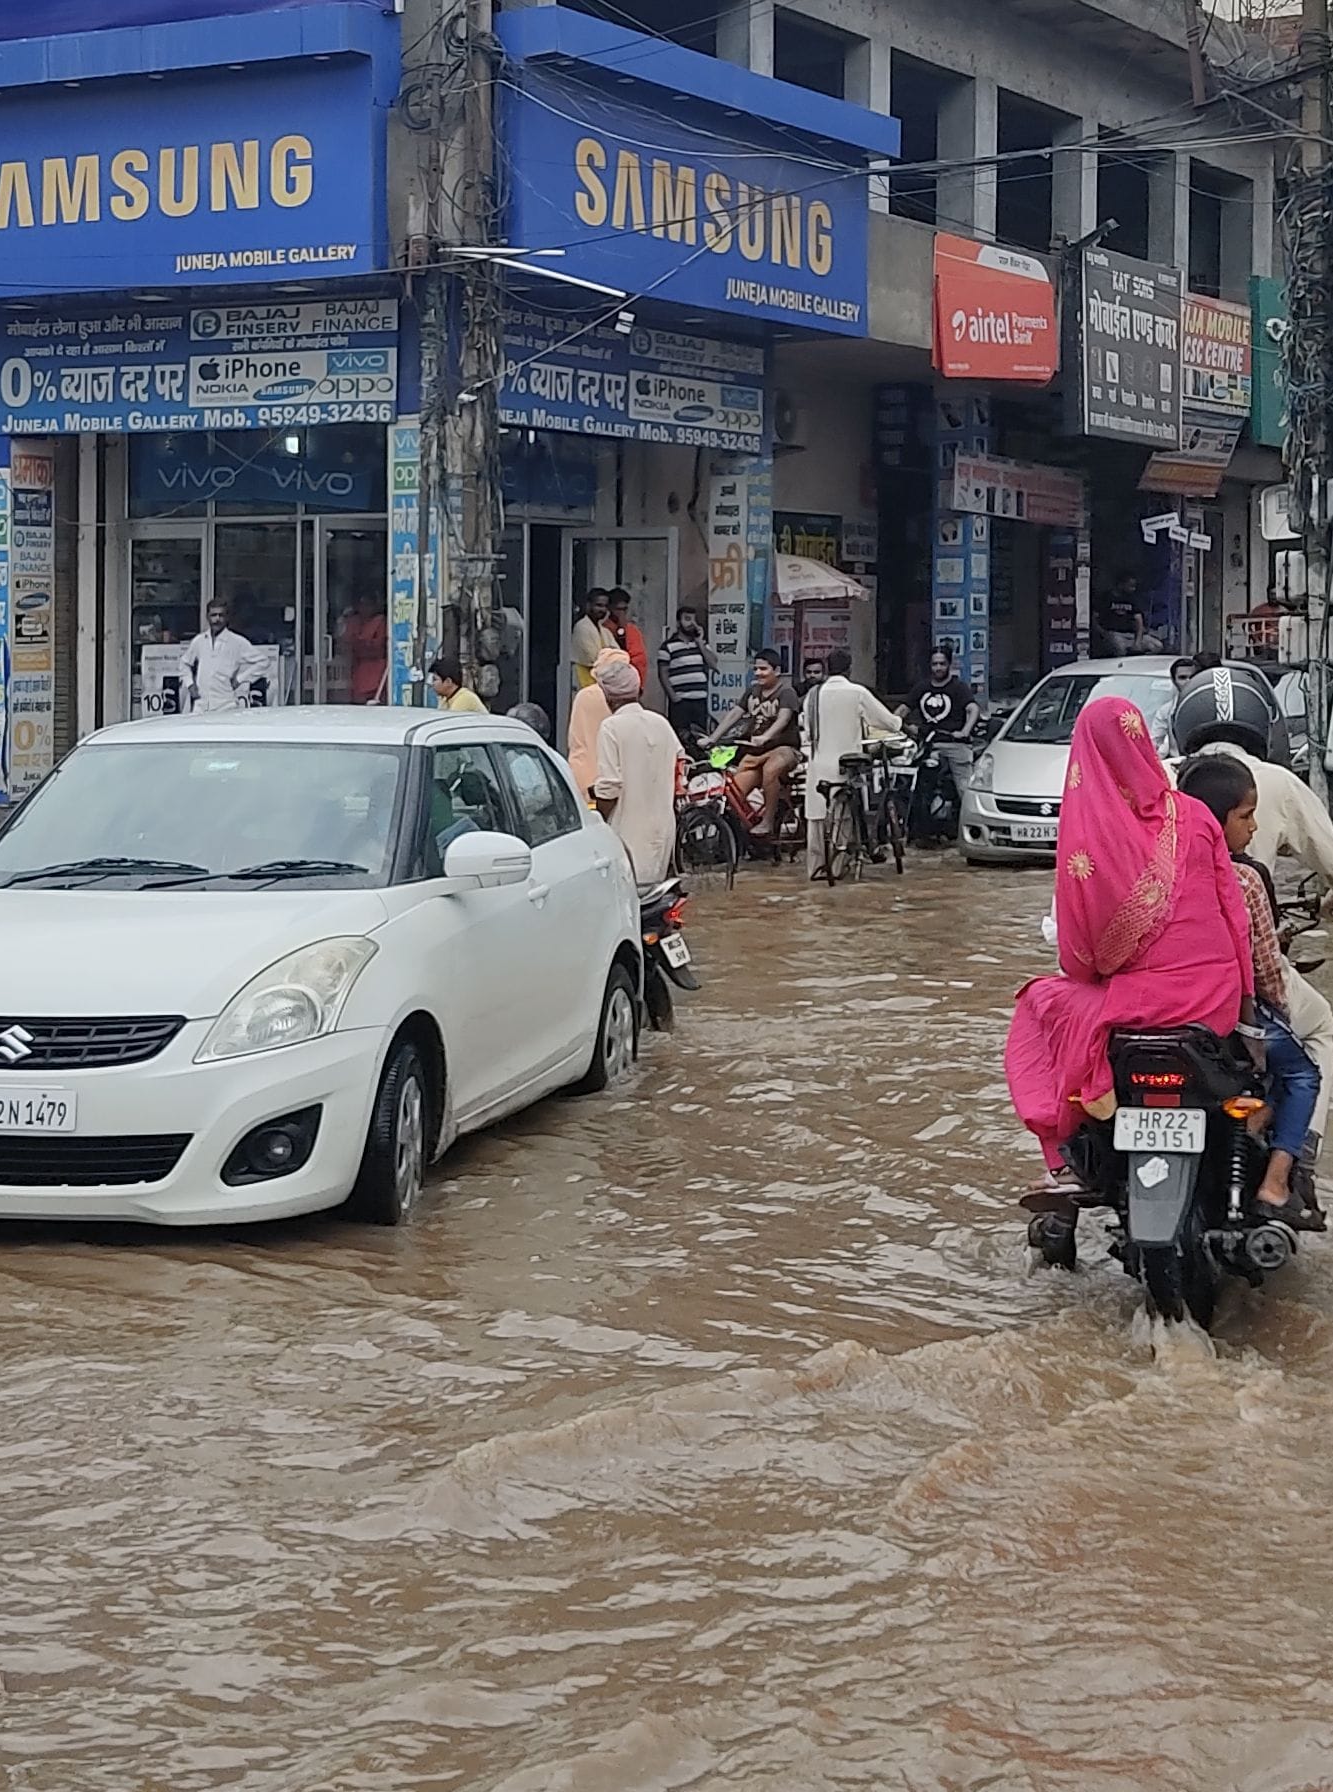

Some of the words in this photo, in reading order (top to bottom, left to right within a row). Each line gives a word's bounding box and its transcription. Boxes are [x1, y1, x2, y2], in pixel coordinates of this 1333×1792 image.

[575, 137, 833, 277] SAMSUNG
[175, 251, 228, 273] JUNEJA
[229, 249, 286, 269] MOBILE
[288, 244, 357, 264] GALLERY
[326, 301, 380, 316] BAJAJ
[726, 276, 769, 305] JUNEJA
[769, 284, 812, 314] MOBILE
[812, 291, 861, 324] GALLERY
[103, 315, 126, 333] और
[127, 314, 142, 331] भी
[226, 307, 300, 321] BAJAJ
[1012, 312, 1048, 330] Payments
[226, 321, 300, 336] FINSERV
[312, 316, 394, 333] FINANCE
[969, 307, 1012, 344] airtel
[1206, 310, 1250, 346] MOBILE
[1013, 329, 1033, 345] Bank
[332, 353, 385, 368] vivo
[1184, 335, 1204, 365] CSC
[1205, 341, 1244, 373] CENTRE
[225, 357, 301, 379] iPhone
[0, 357, 58, 408] 0%
[60, 366, 116, 404] ब्याज
[120, 364, 151, 403] दर
[154, 363, 186, 402] पर
[197, 383, 249, 394] NOKIA
[260, 384, 310, 396] SAMSUNG
[318, 377, 394, 400] oppo
[529, 362, 574, 404] ब्याज
[577, 369, 602, 408] दर
[603, 372, 628, 411] पर
[654, 378, 706, 403] iPhone
[634, 398, 671, 411] NOKIA
[2, 414, 59, 433] JUNEJA
[64, 413, 123, 431] MOBILE
[128, 411, 198, 430] GALLERY
[204, 409, 252, 428] Mob.
[258, 403, 392, 427] 95949-32436
[718, 409, 761, 430] oppo
[498, 408, 528, 425] NEJA
[532, 407, 580, 432] MOBILE
[583, 415, 635, 438] GALLERY
[639, 422, 673, 443] Mob.
[676, 427, 761, 453] 95949-32436
[395, 431, 420, 450] viv
[158, 461, 236, 489] vivo
[272, 462, 354, 495] vivo
[20, 552, 47, 562] BAJAJ
[13, 562, 53, 574] FINANCE
[22, 579, 51, 590] iPhone
[710, 671, 743, 689] CASH
[710, 692, 738, 712] BAC
[14, 719, 52, 751] 0%
[1030, 827, 1042, 838] 22
[8, 1101, 20, 1125] N
[25, 1102, 67, 1127] 1479
[1138, 1112, 1189, 1130] HR22
[1133, 1130, 1194, 1149] P9151
